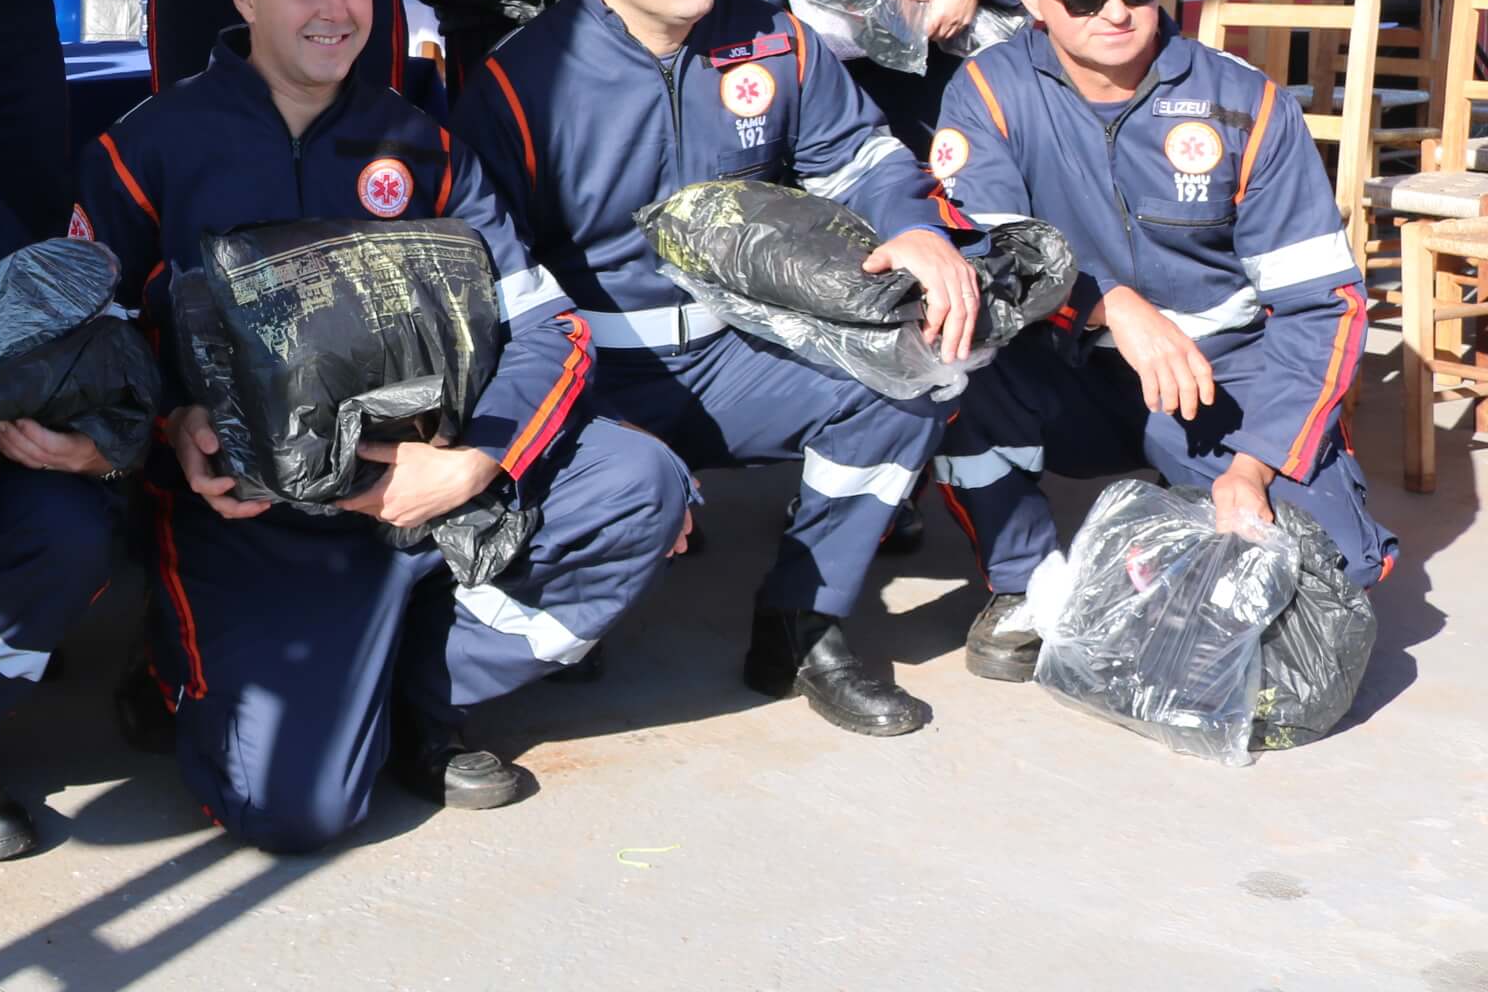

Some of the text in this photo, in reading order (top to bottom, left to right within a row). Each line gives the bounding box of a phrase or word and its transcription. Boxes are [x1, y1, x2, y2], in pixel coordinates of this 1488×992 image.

[729, 46, 752, 59] JOEL
[1158, 100, 1207, 115] ELIZEU
[735, 114, 767, 131] SAMU
[738, 126, 766, 149] 192
[1174, 171, 1211, 185] SAMU
[1176, 183, 1209, 202] 192
